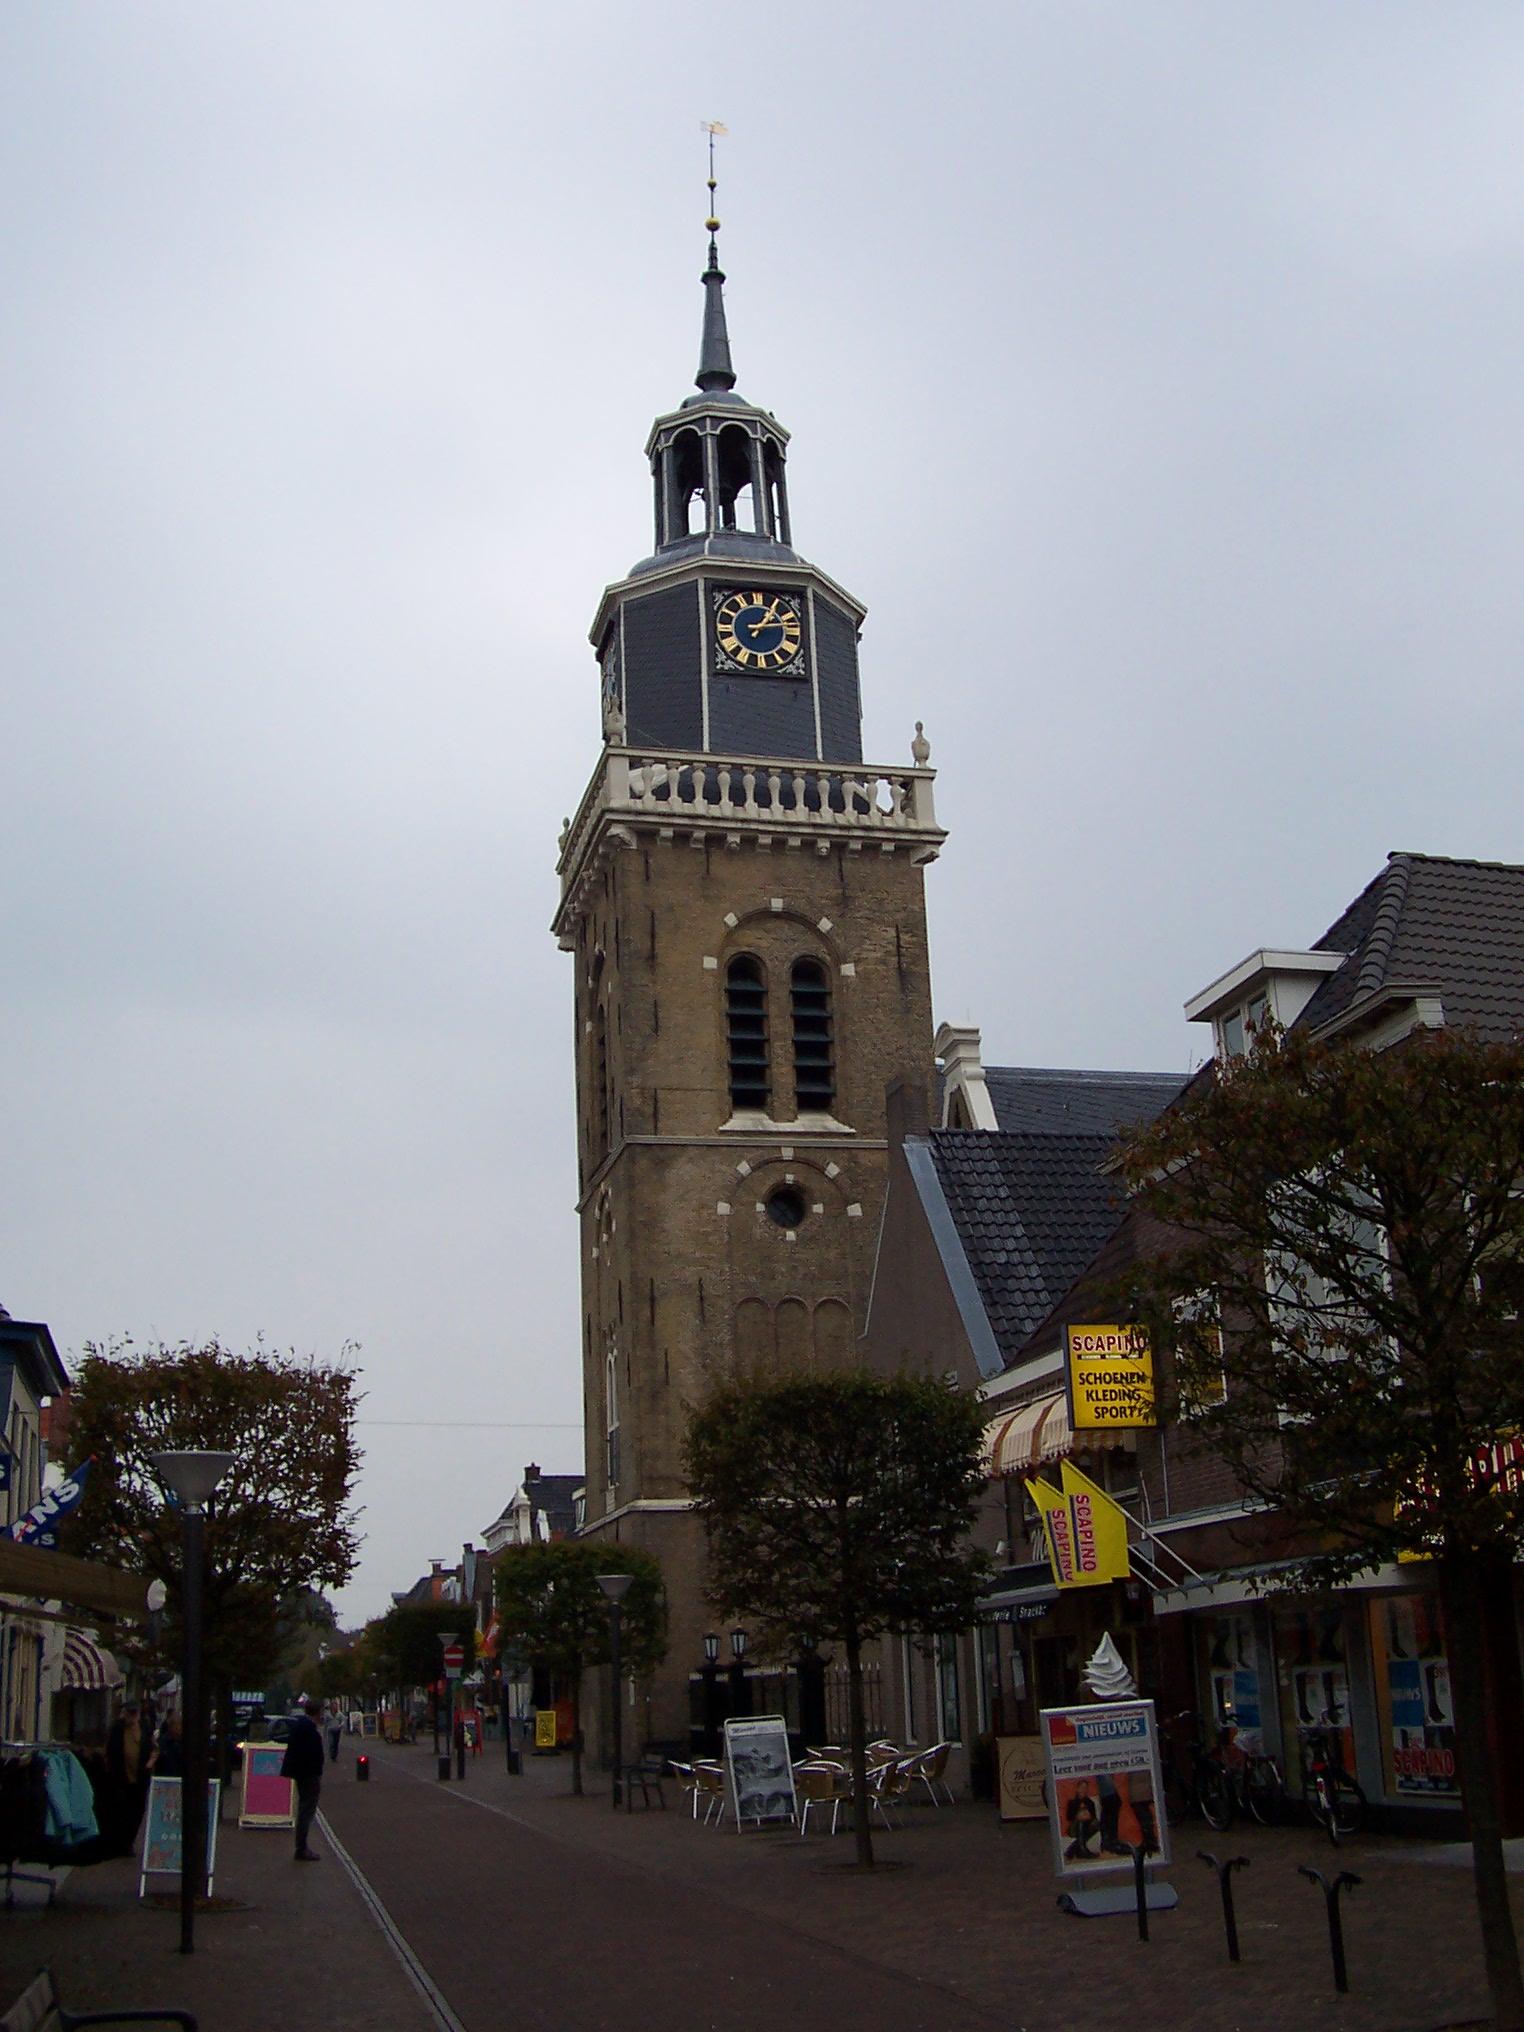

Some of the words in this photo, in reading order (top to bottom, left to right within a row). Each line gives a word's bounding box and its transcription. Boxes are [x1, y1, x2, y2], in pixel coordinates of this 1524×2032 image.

[1072, 1334, 1147, 1351] SCAPINO
[1078, 1372, 1145, 1386] SCHOENEN
[1086, 1389, 1141, 1402] KLEDING
[1094, 1406, 1136, 1419] SPORT
[1076, 1494, 1097, 1572] SCAPINO
[1083, 1719, 1140, 1738] NIEUWS
[1392, 1748, 1454, 1776] SCAPINO
